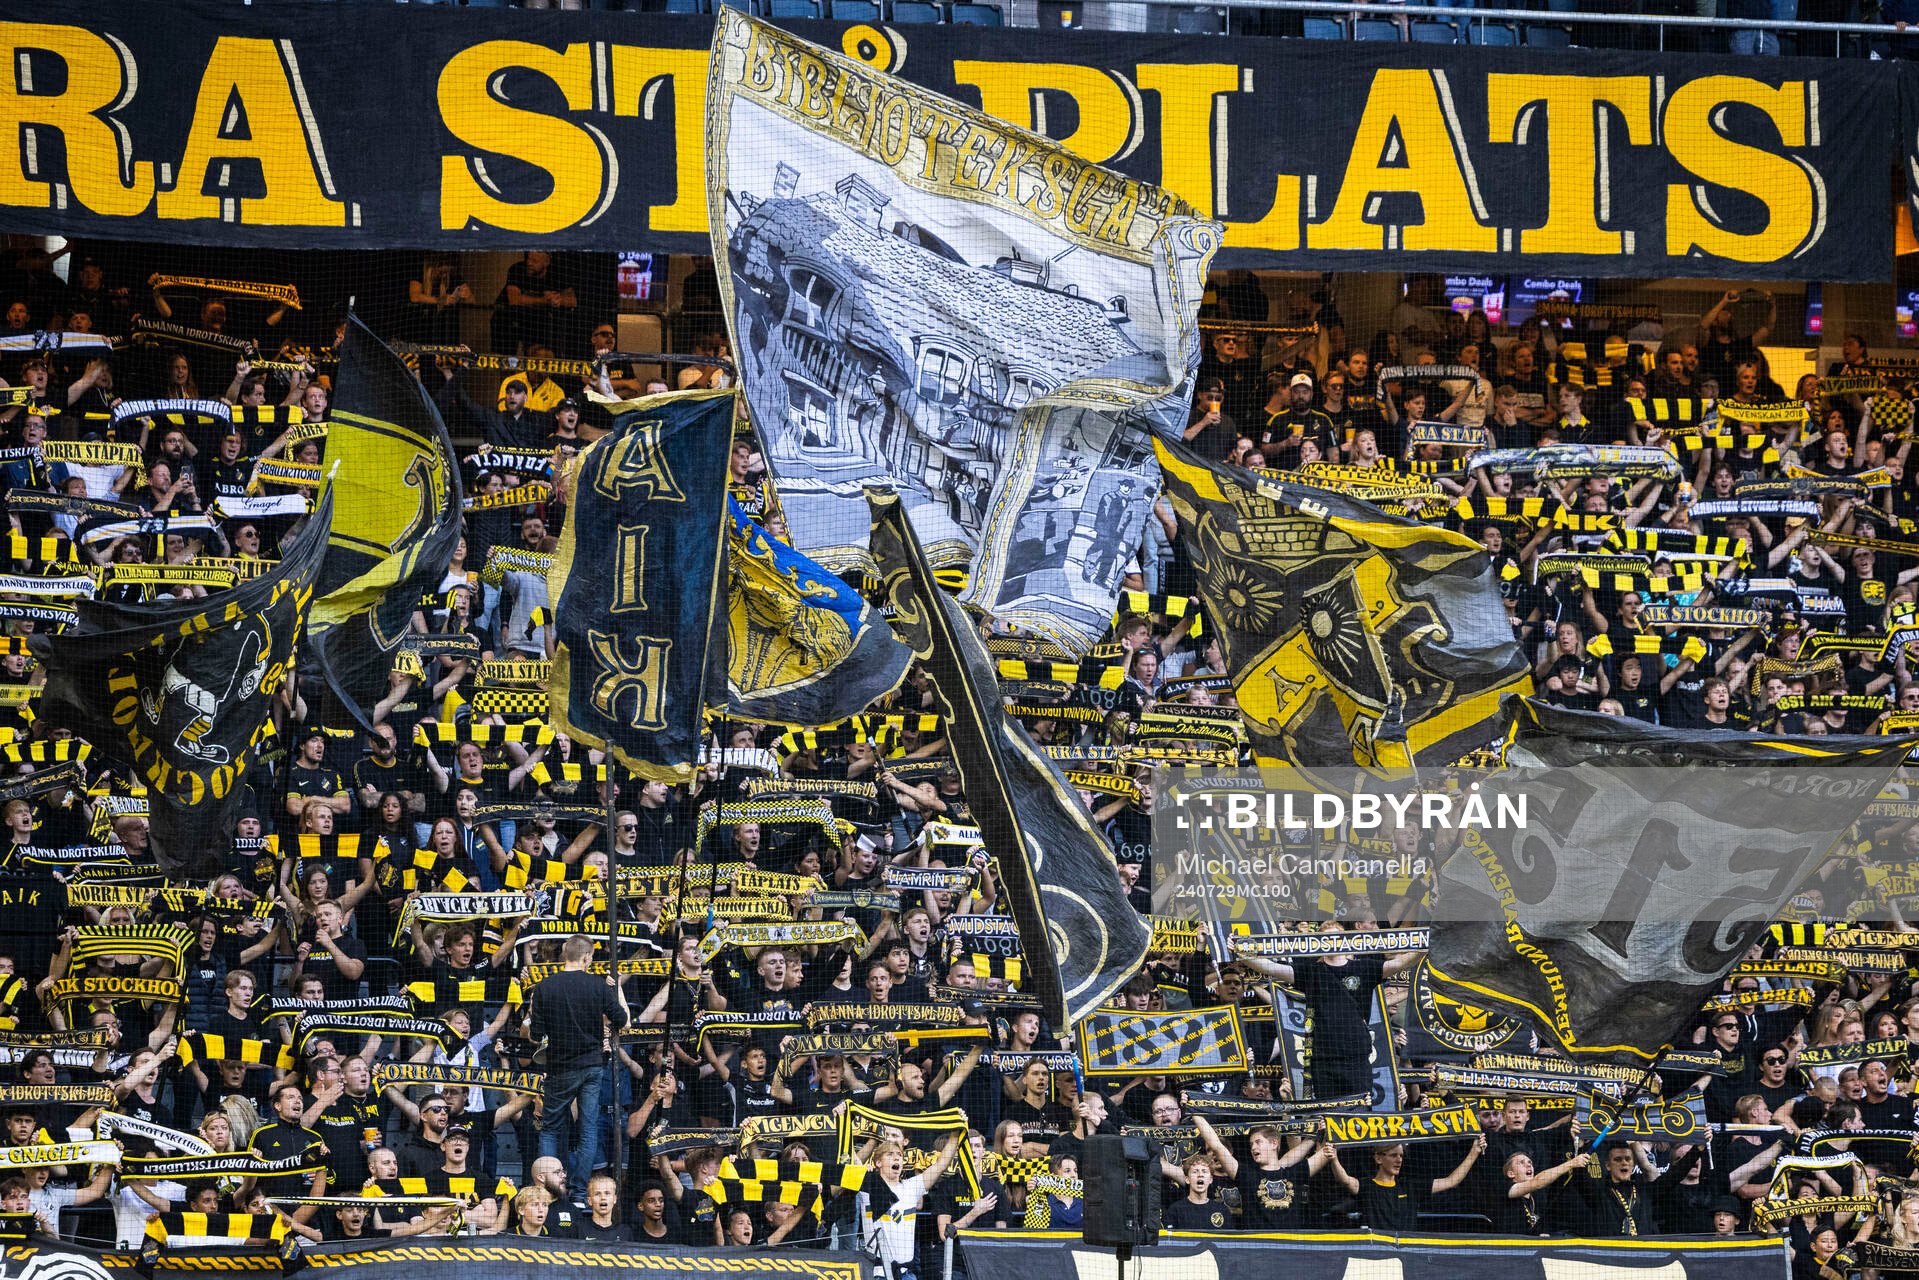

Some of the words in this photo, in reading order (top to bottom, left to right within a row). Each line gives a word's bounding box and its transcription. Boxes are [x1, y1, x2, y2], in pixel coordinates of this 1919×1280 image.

[436, 24, 1816, 263] STPLATS
[541, 919, 579, 934] NORRA
[1263, 931, 1430, 955] HUVUDSTAGRABBEN
[1740, 959, 1829, 976] STÅPLATS
[1428, 1018, 1511, 1050] STOCKHOLM
[1324, 1114, 1429, 1141] NORRA
[1430, 1101, 1482, 1136] STÅ
[9, 1143, 84, 1165] GNAGET
